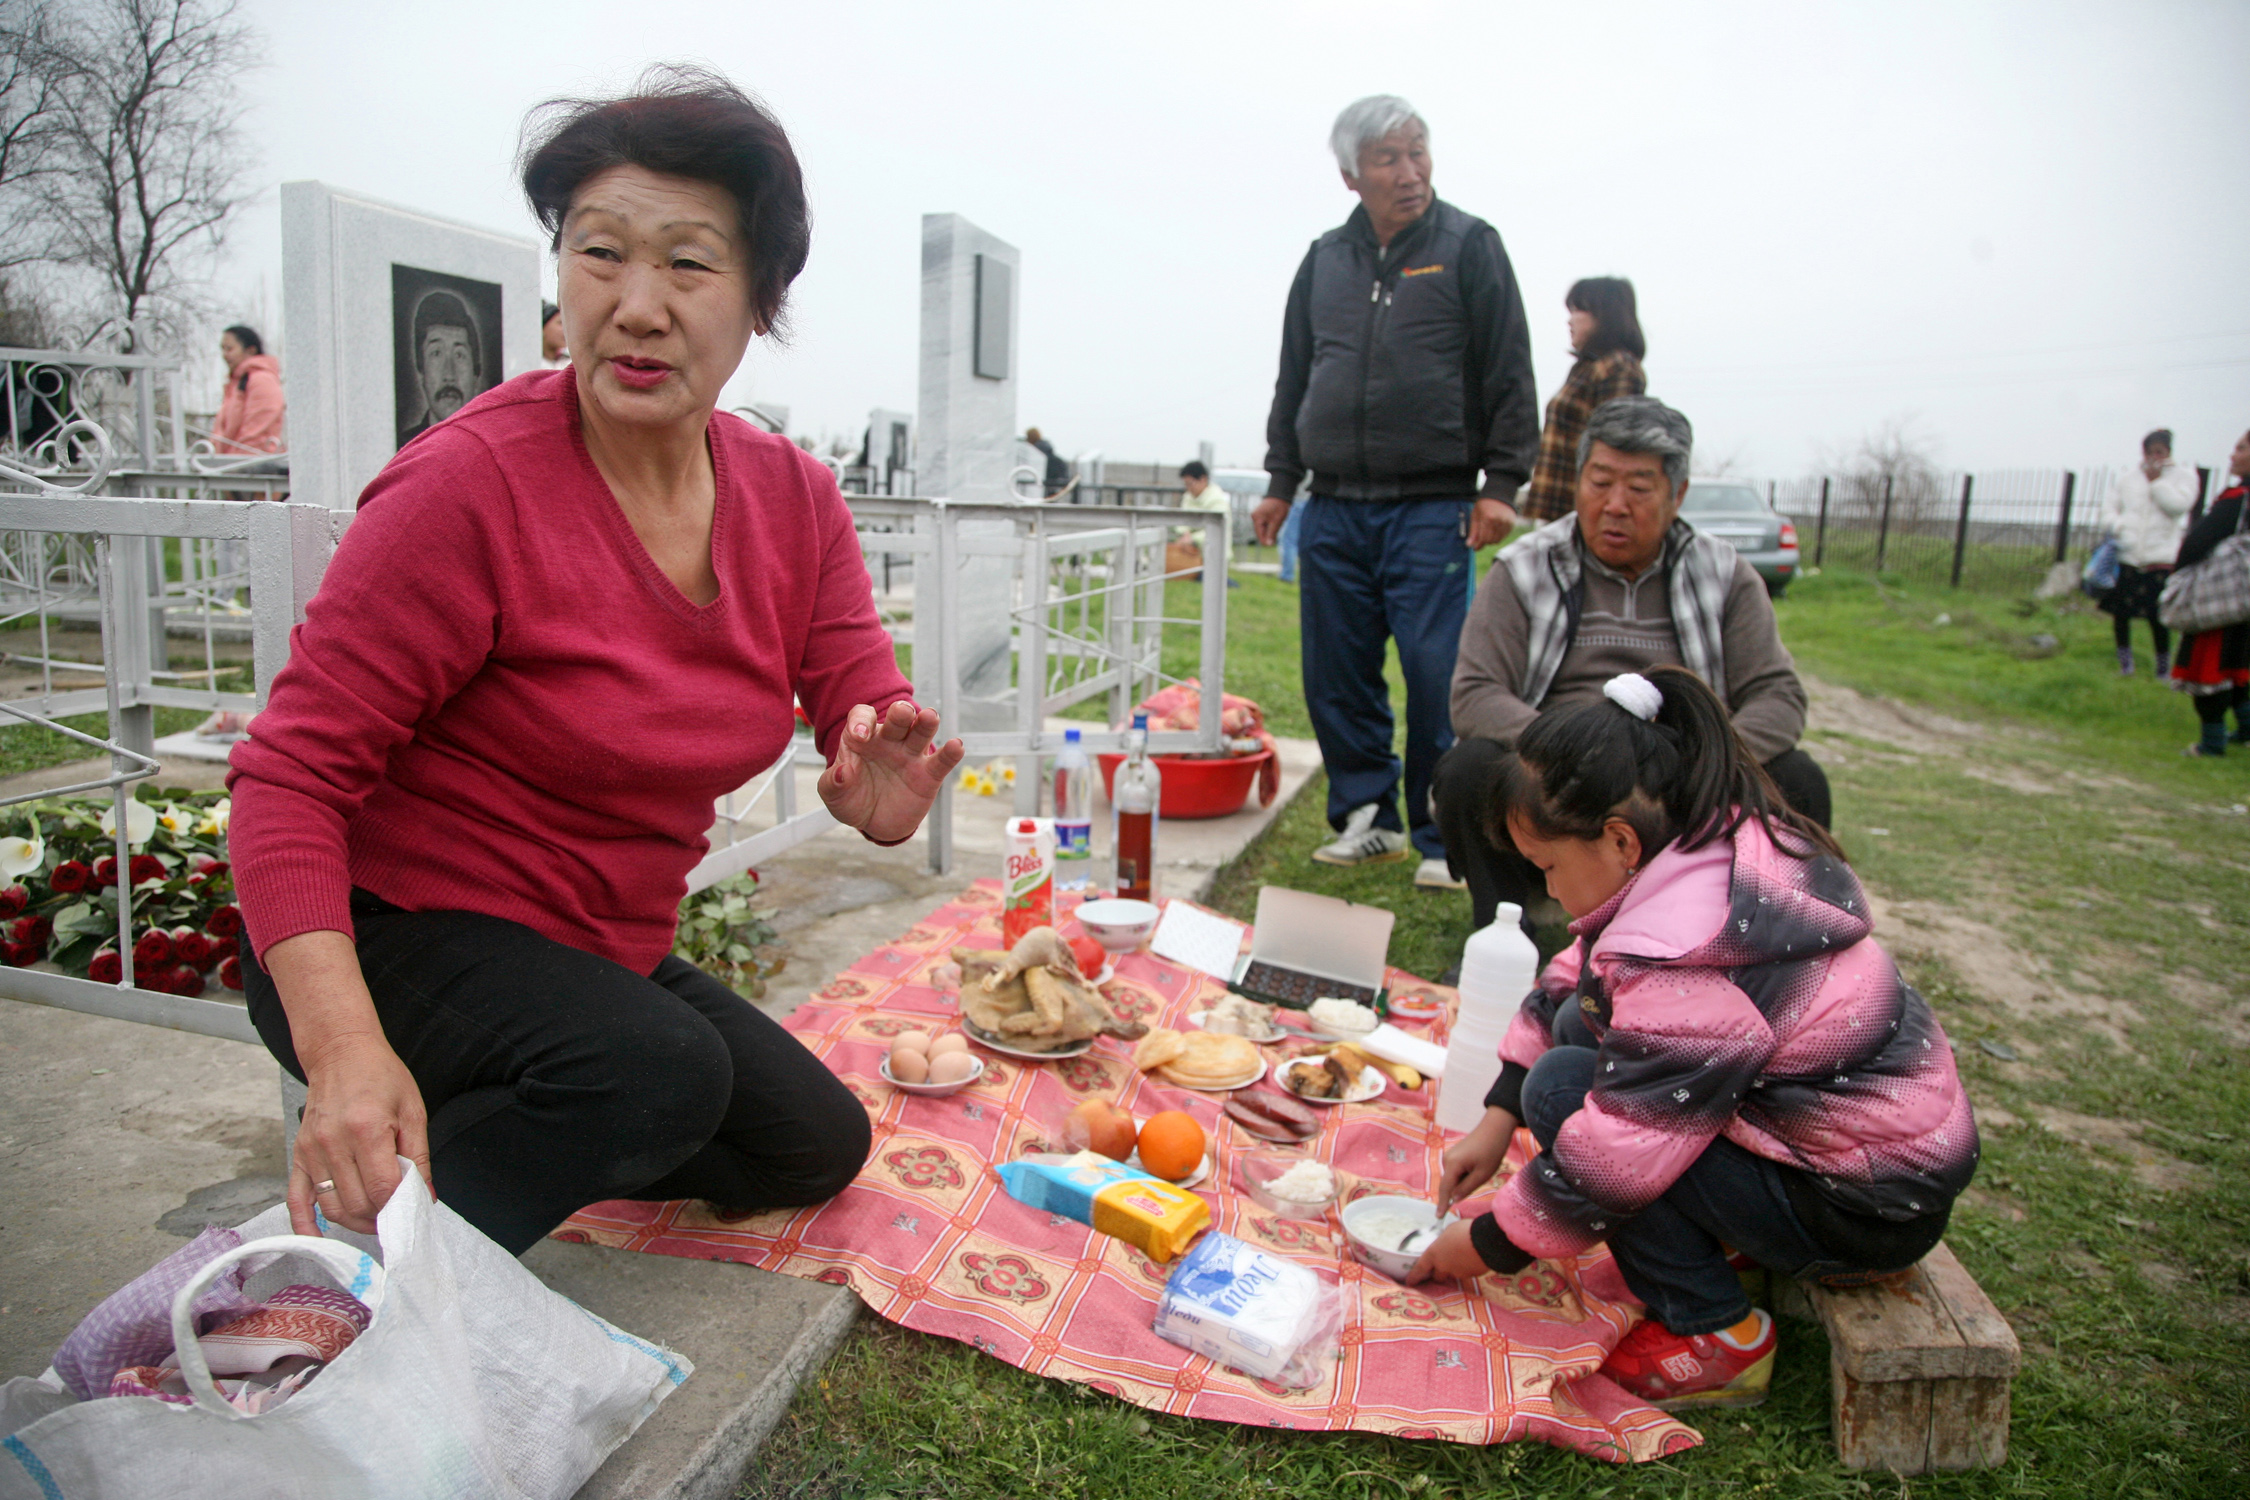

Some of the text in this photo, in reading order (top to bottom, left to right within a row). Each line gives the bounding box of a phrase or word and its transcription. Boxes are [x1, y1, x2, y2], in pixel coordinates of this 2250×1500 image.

[1007, 854, 1043, 879] Bliss
[1222, 1254, 1281, 1309] Леди
[1661, 1351, 1703, 1382] 55
